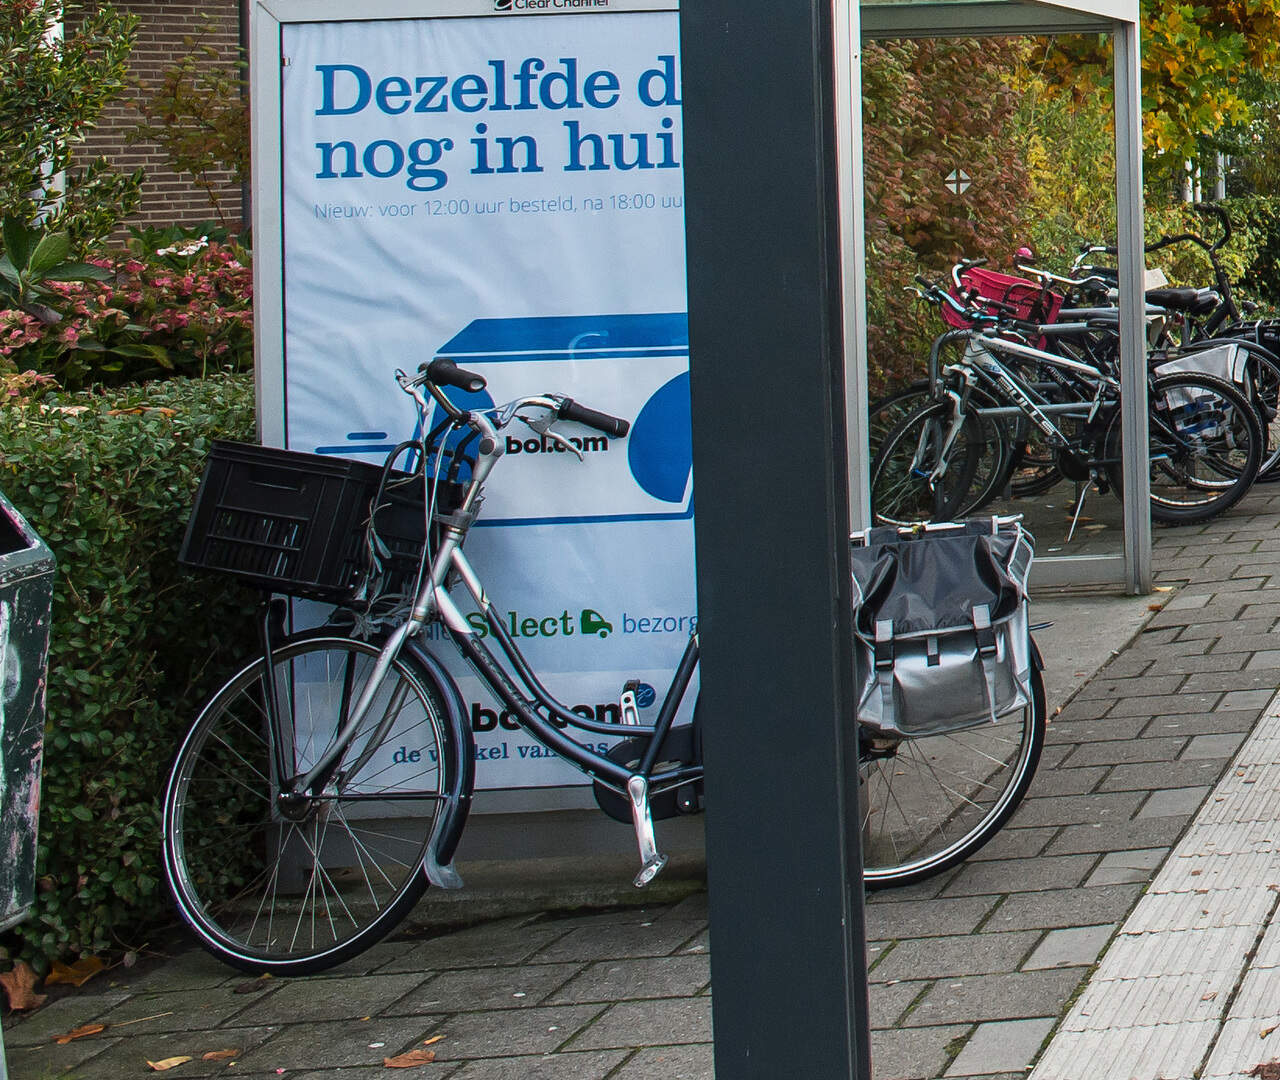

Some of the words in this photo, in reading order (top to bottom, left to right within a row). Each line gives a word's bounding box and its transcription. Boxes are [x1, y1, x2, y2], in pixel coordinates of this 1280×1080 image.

[315, 57, 621, 116] Dezelfde
[315, 137, 455, 192] nog
[470, 123, 544, 175] in
[563, 117, 681, 172] hui
[315, 204, 374, 219] Nieuw:
[379, 204, 416, 217] voor
[424, 200, 470, 216] 12:00
[475, 201, 504, 215] uur
[509, 196, 578, 215] besteld,
[583, 199, 604, 211] na
[609, 194, 656, 210] 18:00
[465, 609, 574, 638] Slect
[392, 746, 421, 764] de
